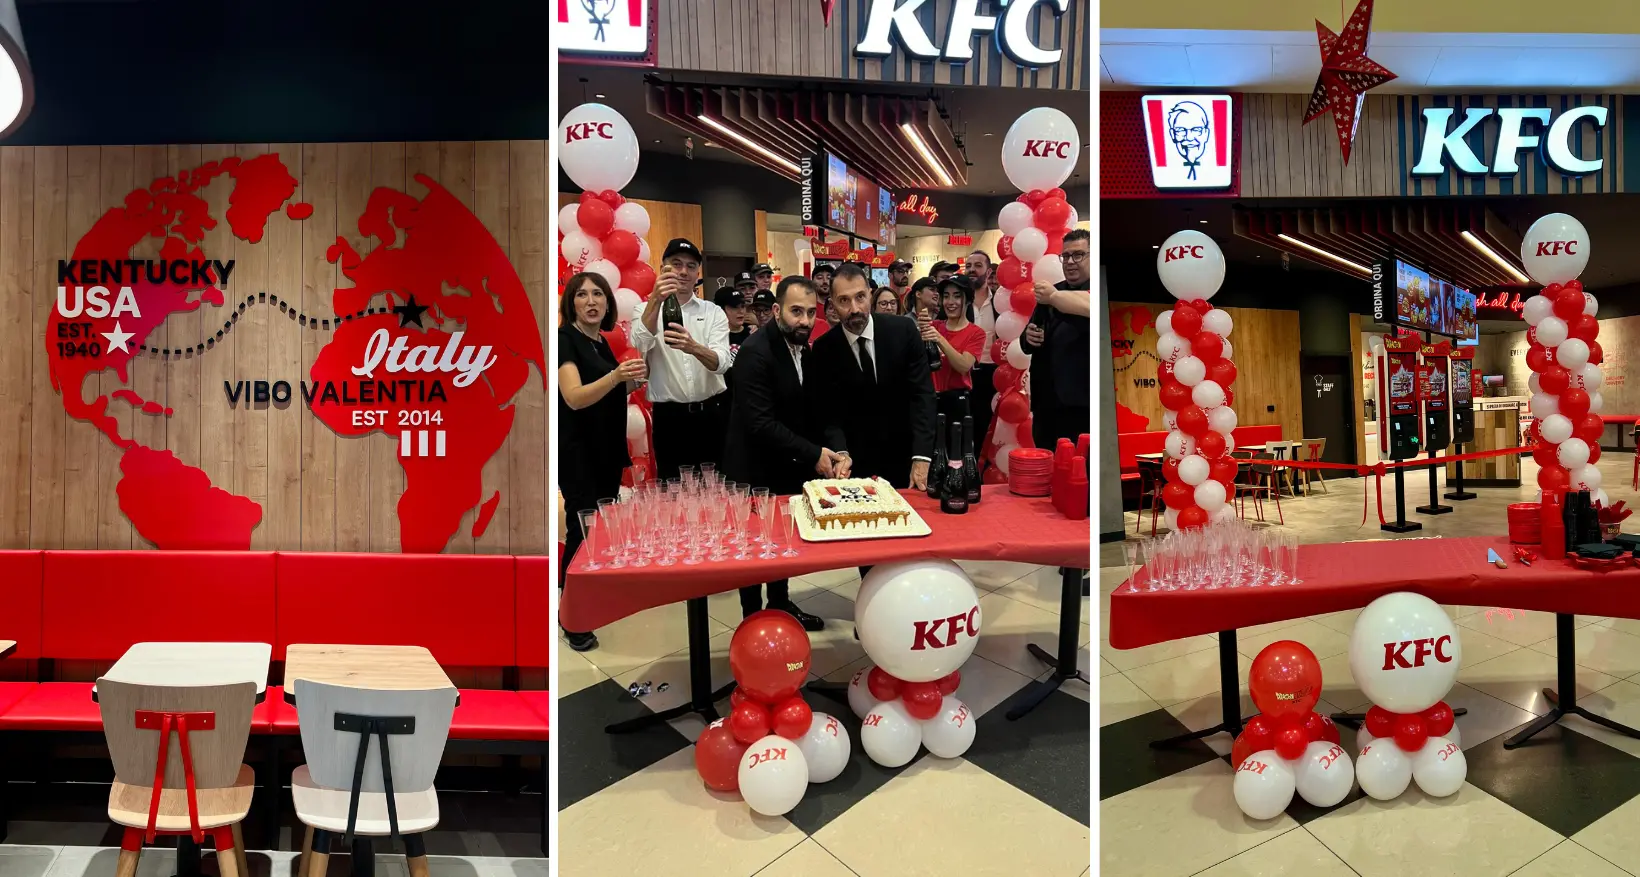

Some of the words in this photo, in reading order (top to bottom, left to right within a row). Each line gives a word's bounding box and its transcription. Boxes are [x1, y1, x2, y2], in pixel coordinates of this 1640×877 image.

[855, 0, 1069, 66] KFC
[566, 122, 614, 144] KFC
[1411, 105, 1608, 176] KFC
[1022, 139, 1071, 159] KFC
[802, 157, 813, 177] QUI
[802, 179, 813, 221] ORDINA
[900, 194, 916, 213] all
[919, 196, 939, 224] day
[1165, 245, 1204, 263] KFC
[1536, 240, 1578, 256] KFC
[57, 259, 235, 286] KENTUCKY
[1373, 263, 1383, 281] QUI
[57, 286, 142, 318] USA
[1374, 282, 1383, 320] ORDINA
[1491, 292, 1509, 308] all
[57, 322, 96, 339] EST.
[57, 342, 100, 358] 1940
[351, 328, 498, 388] Italy
[1170, 346, 1180, 362] KFC
[1166, 361, 1174, 373] KF
[224, 381, 292, 405] VIBO
[300, 380, 448, 404] VALENTIA
[1134, 378, 1155, 388] VIBO
[352, 410, 388, 426] EST
[398, 410, 444, 426] 2014
[911, 605, 980, 651] KFC
[1382, 634, 1453, 671] KFC
[863, 714, 883, 727] KF
[748, 747, 788, 769] KFC
[1237, 760, 1269, 775] KFC
[1319, 745, 1345, 770] KFC
